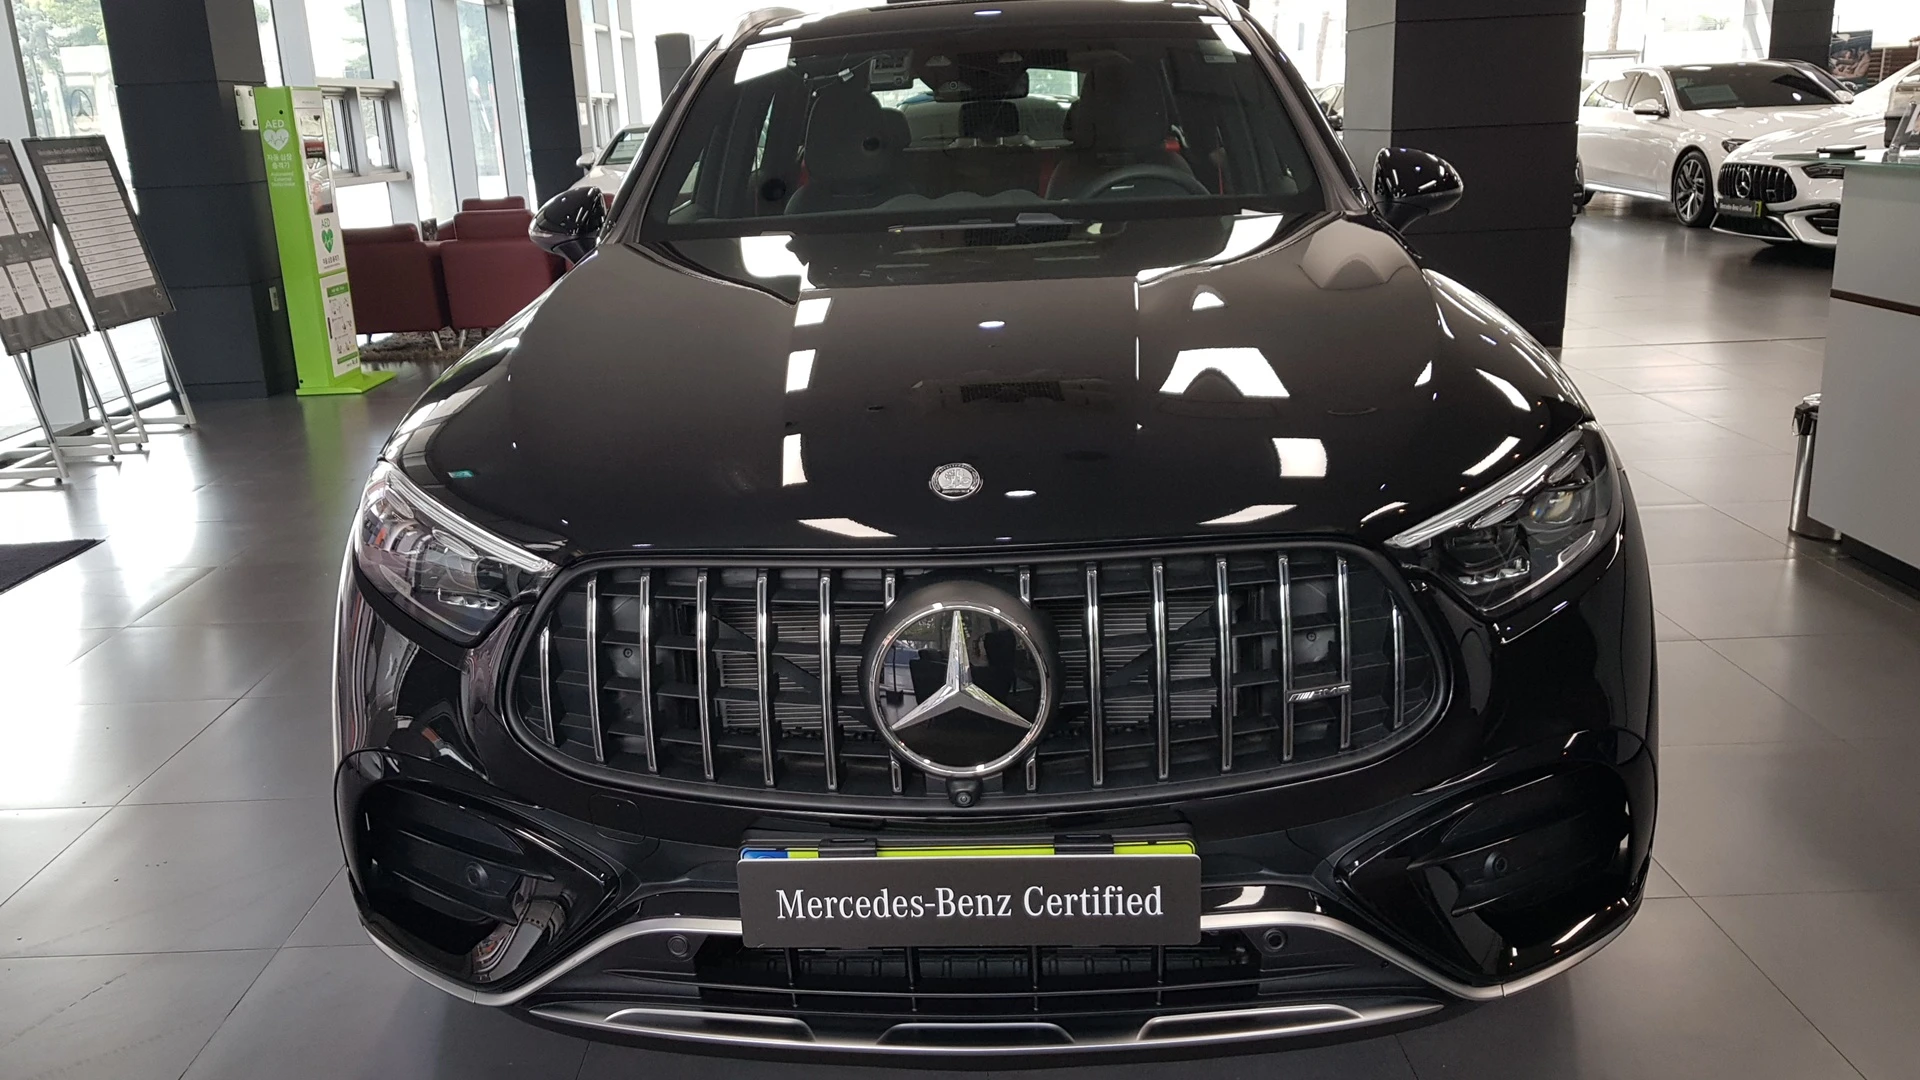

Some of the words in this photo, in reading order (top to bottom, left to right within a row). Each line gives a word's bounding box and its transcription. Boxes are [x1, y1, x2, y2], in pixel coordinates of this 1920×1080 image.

[265, 119, 285, 129] AED
[321, 218, 331, 229] AED
[775, 886, 1013, 919] Mercedes-Benz
[1023, 885, 1164, 917] Certified
